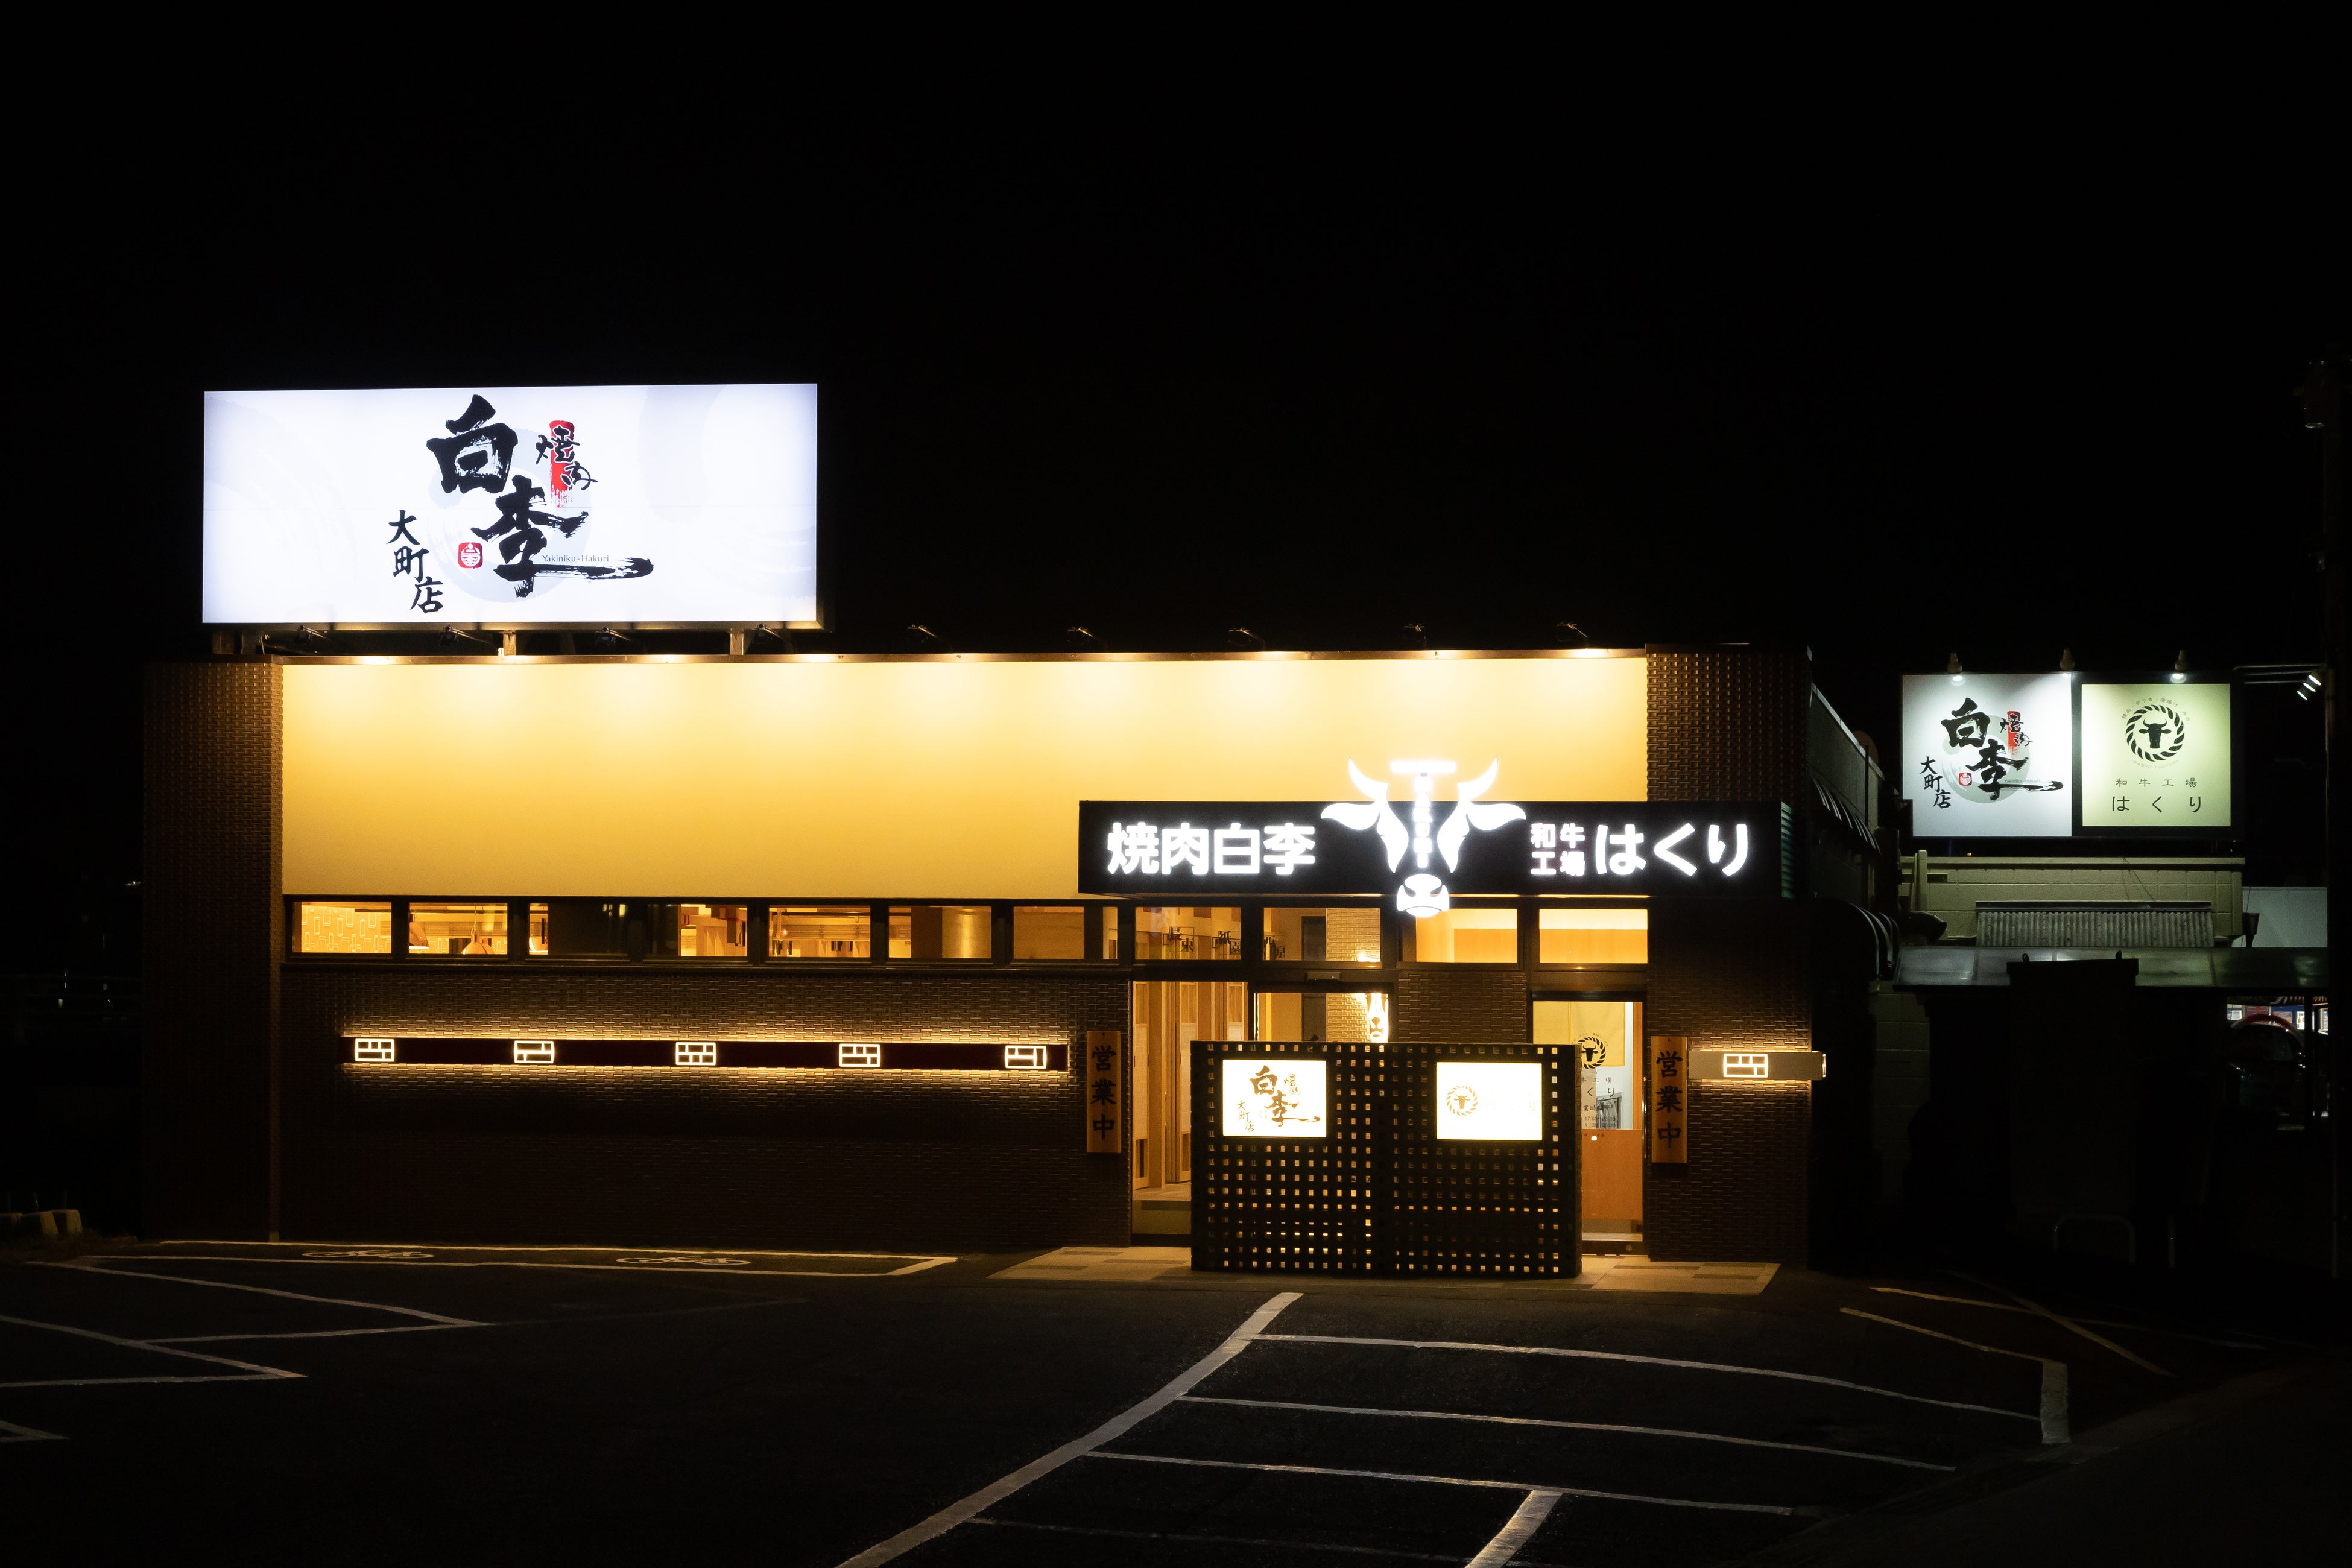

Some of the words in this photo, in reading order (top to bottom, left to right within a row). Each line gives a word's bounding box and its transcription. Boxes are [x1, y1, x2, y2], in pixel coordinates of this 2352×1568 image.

[426, 394, 654, 598] 白李
[386, 509, 444, 614] 大町店
[1941, 697, 2064, 800] 白李
[1920, 756, 1952, 809] 大町店
[2112, 796, 2201, 813] はくり
[2116, 777, 2197, 788] 和牛工場
[1107, 822, 1315, 875] 焼肉白李
[1531, 823, 1585, 848] 和牛
[1596, 823, 1748, 876] はくり
[1090, 1045, 1116, 1140] 営業中
[1238, 1100, 1254, 1131] 大町店
[1250, 1065, 1321, 1127] 白李
[1655, 1050, 1683, 1149] 営業中
